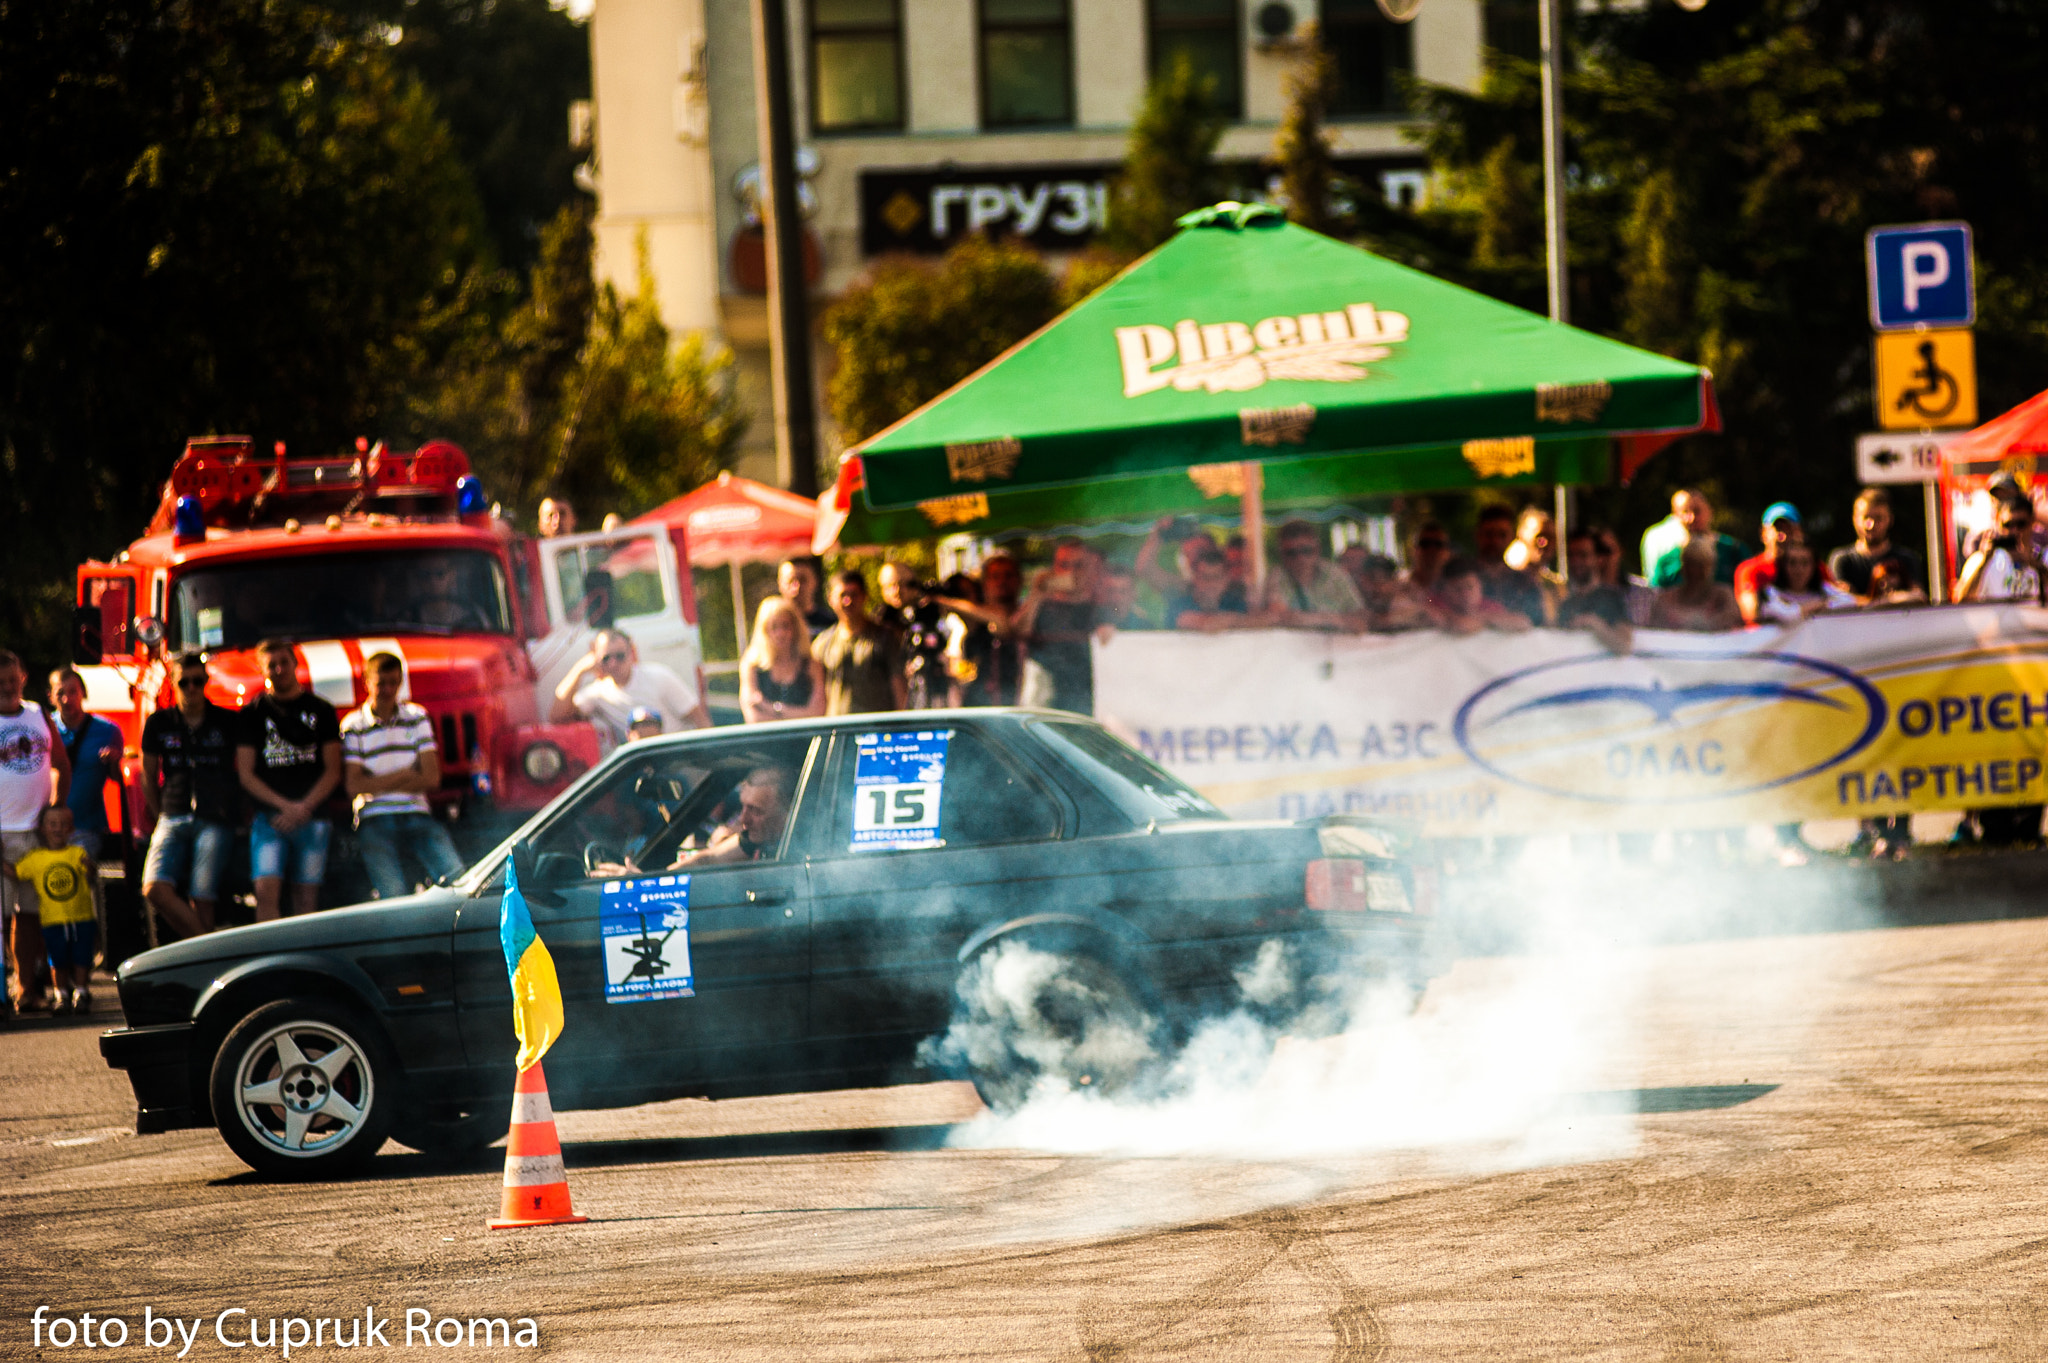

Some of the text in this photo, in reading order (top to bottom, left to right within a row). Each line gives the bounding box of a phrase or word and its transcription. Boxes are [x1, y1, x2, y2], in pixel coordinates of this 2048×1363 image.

[1901, 240, 1950, 312] P
[1138, 722, 1438, 764] МЕРЕЖА АЗС
[1838, 758, 2042, 804] ПАРТНЕР
[869, 789, 925, 825] 15
